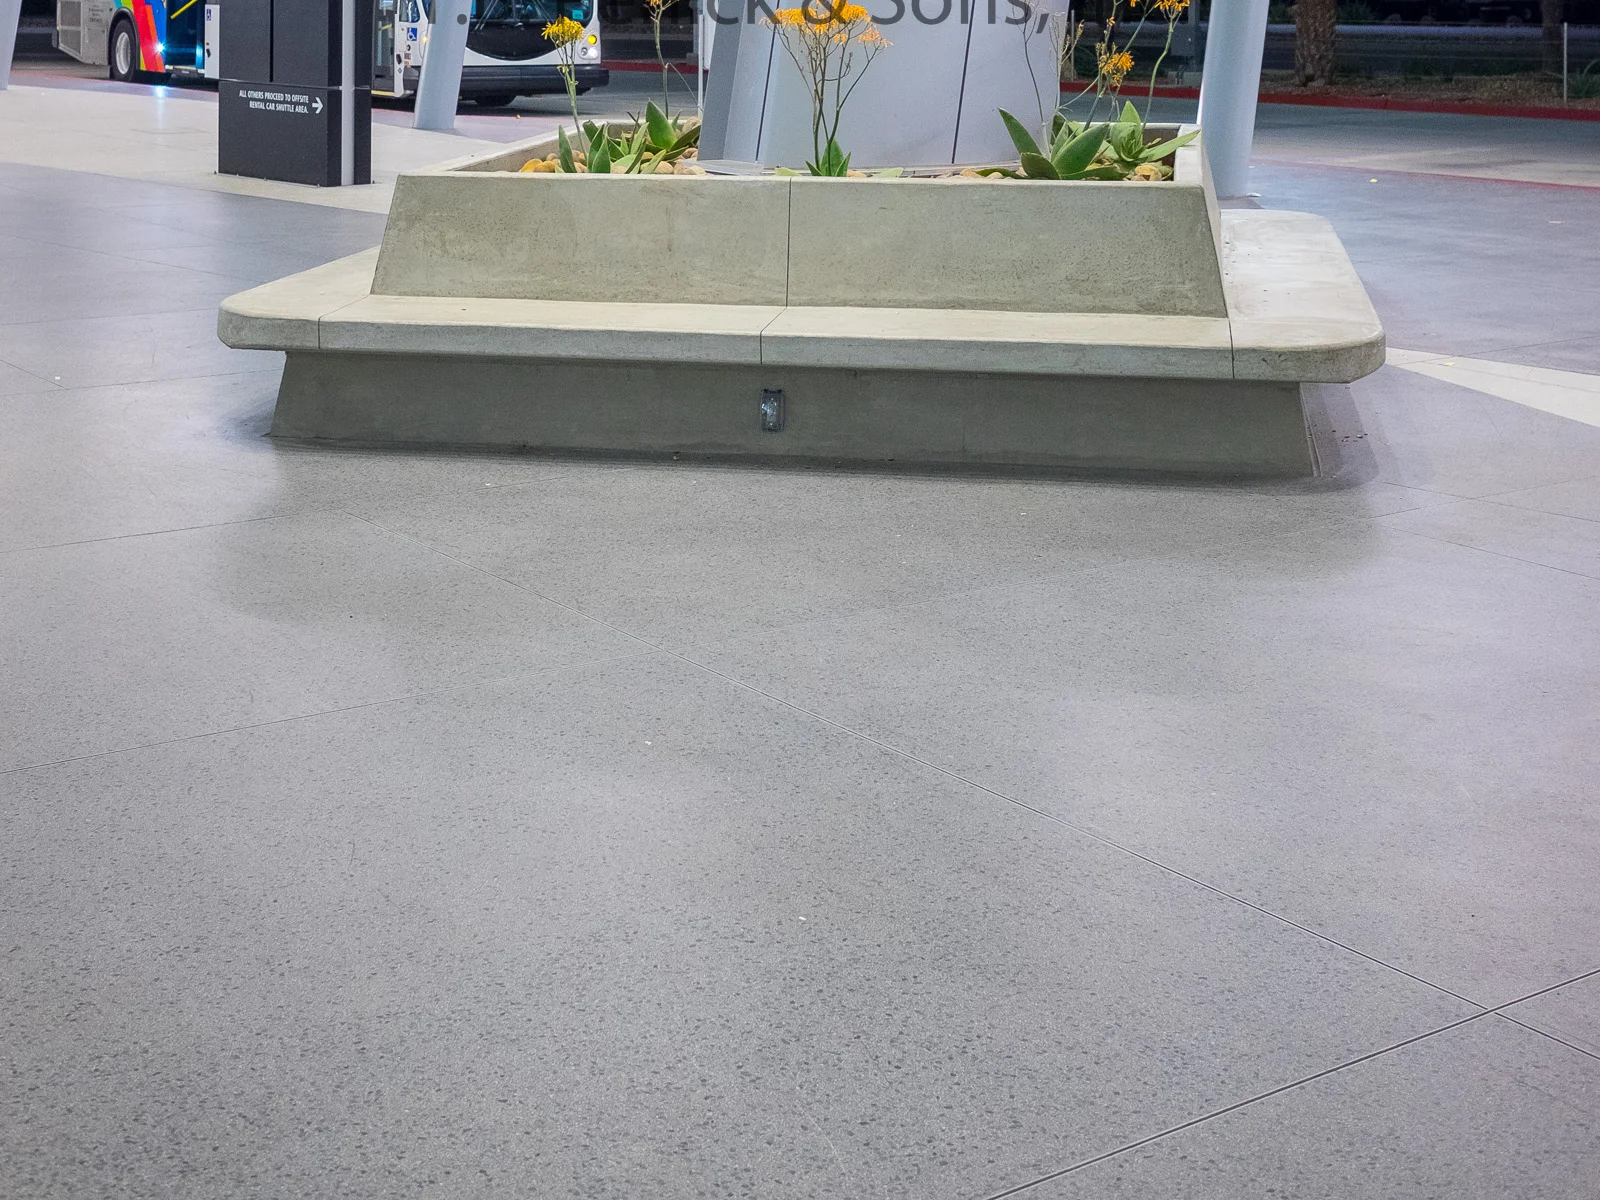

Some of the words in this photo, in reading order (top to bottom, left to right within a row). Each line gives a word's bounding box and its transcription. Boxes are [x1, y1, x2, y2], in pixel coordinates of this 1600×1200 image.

[238, 89, 247, 98] ALL
[247, 90, 264, 99] OTHERS
[264, 91, 284, 101] PROCEED
[285, 93, 291, 102] TO
[292, 94, 309, 103] OFFSITE
[249, 101, 265, 110] RENTAL
[266, 102, 275, 111] CAR
[276, 103, 294, 113] SHUTTLE
[295, 105, 309, 114] AREA.
